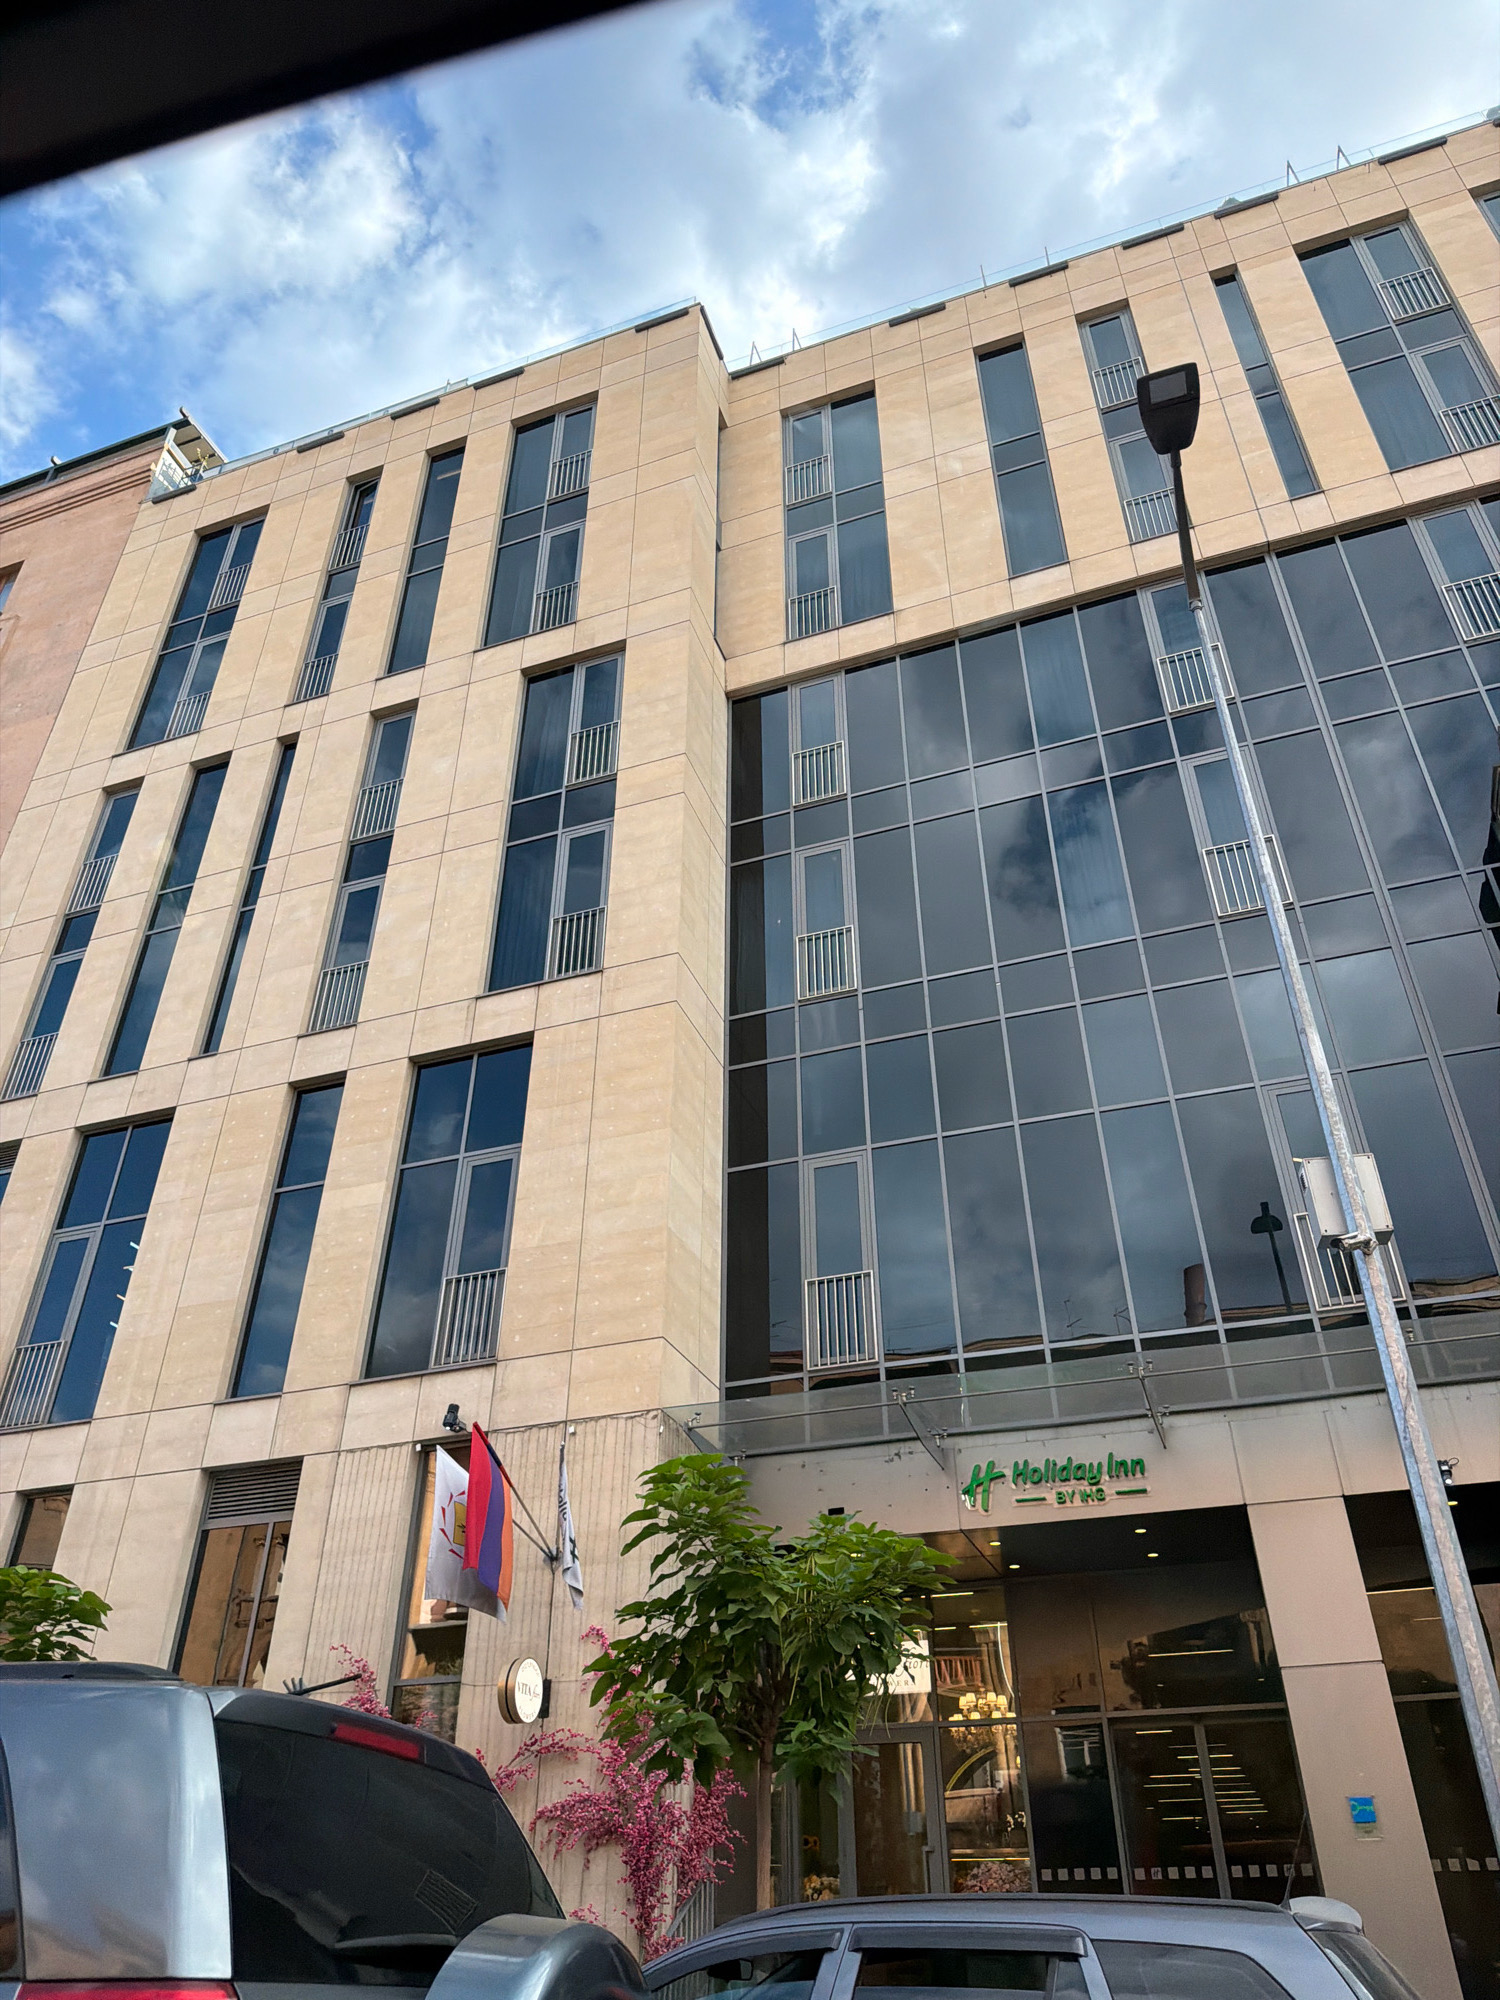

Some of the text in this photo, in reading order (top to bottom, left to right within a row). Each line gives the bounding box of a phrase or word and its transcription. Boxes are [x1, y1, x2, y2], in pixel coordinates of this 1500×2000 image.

[1012, 1452, 1145, 1485] Holiday Inn
[1055, 1487, 1106, 1504] BY IHG
